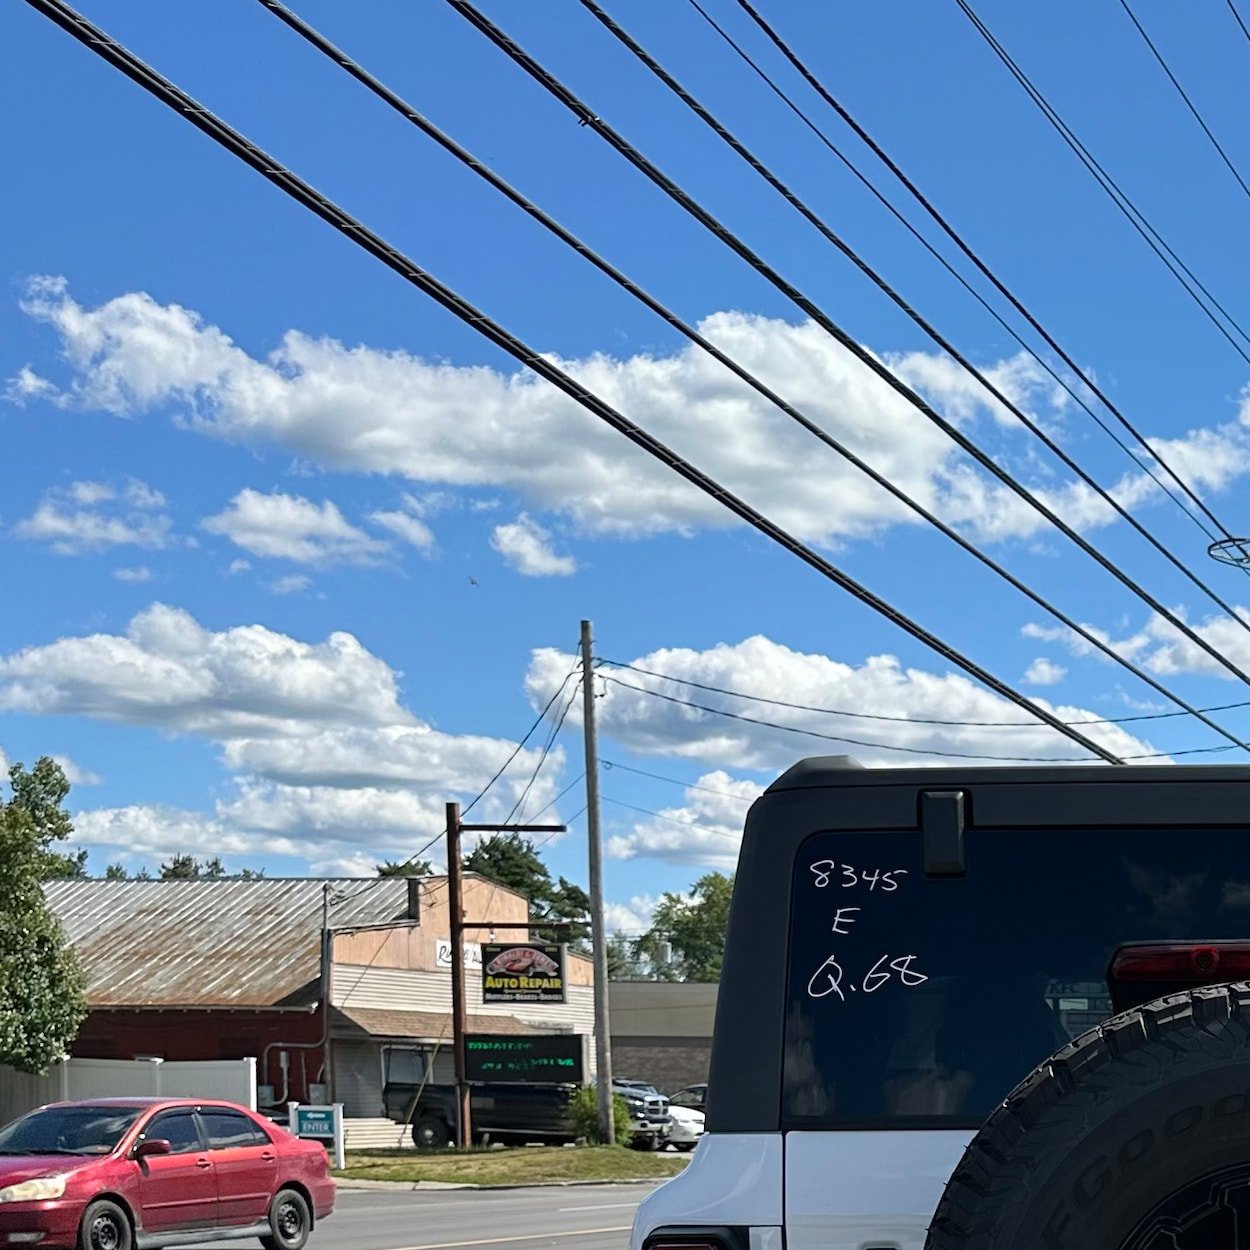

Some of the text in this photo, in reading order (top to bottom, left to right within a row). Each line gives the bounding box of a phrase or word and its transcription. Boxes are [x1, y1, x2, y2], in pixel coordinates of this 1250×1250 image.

[809, 859, 909, 891] 8345
[831, 906, 862, 935] E
[485, 976, 562, 989] AUTO REPAIR
[302, 1122, 330, 1132] ENTER
